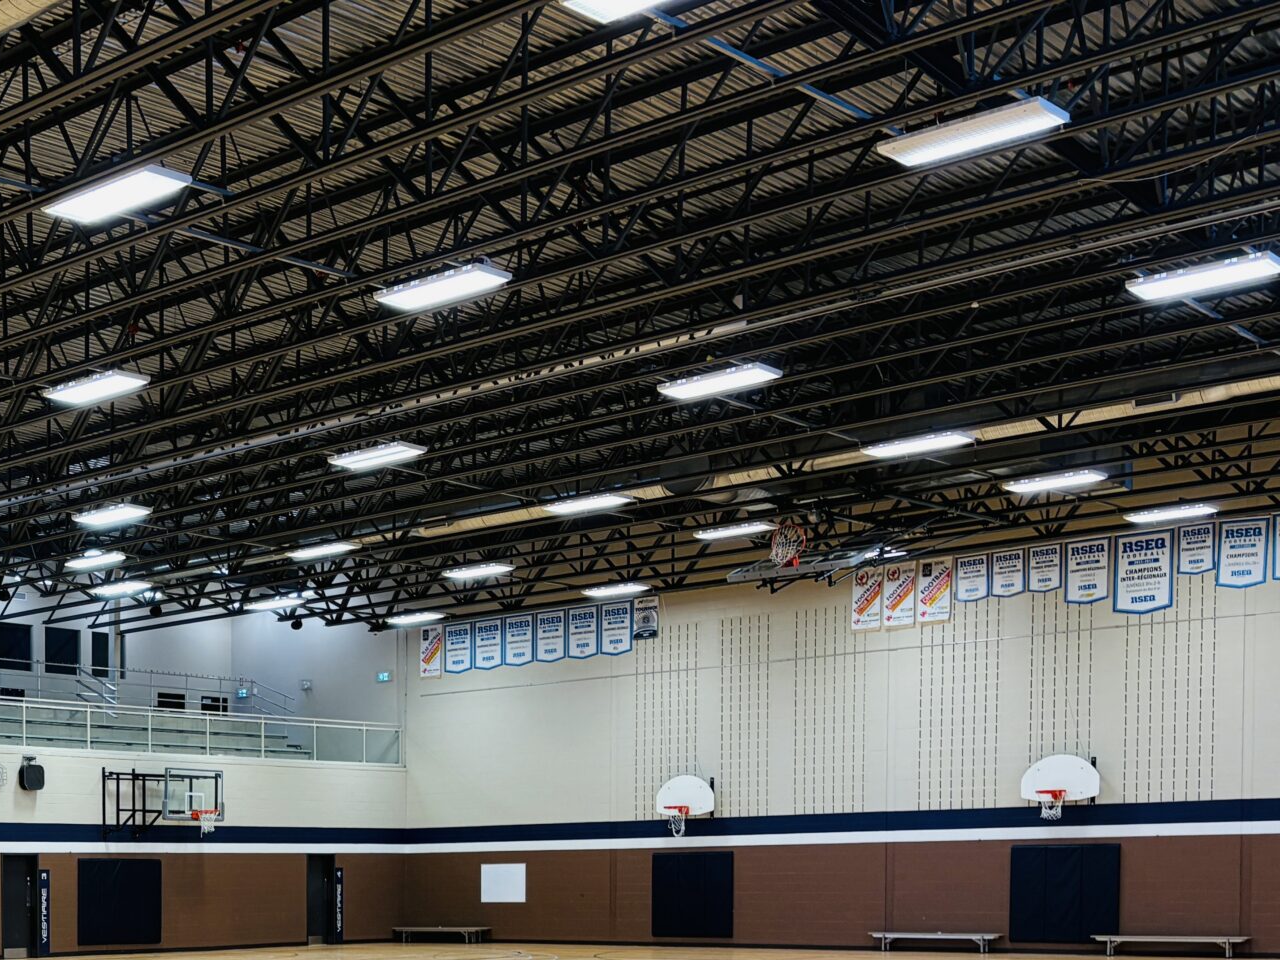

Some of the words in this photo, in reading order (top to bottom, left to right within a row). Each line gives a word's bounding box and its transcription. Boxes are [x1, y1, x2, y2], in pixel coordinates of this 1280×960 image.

[1182, 527, 1210, 538] RSEQ
[1224, 527, 1263, 539] RSEQ
[1070, 543, 1106, 557] RSEQ
[1121, 537, 1167, 554] RSEQ
[995, 552, 1021, 563] RSEQ
[1032, 547, 1058, 558] RSEQ
[1121, 550, 1166, 559] FOOTBALL
[959, 557, 985, 568] RSEQ
[1125, 566, 1162, 575] CHAMPIONS
[920, 565, 950, 595] FOOTBALL
[854, 579, 878, 605] FOOTBALL
[886, 575, 911, 601] FOOTBALL
[1130, 594, 1156, 604] RSEQ
[571, 611, 594, 622] RSEQ
[604, 607, 628, 617] RSEQ
[508, 620, 530, 630] RSEQ
[539, 615, 562, 626] RSEQ
[447, 628, 469, 638] RSEQ
[477, 624, 499, 634] RSEQ
[41, 872, 47, 880] 3
[336, 870, 342, 878] 4
